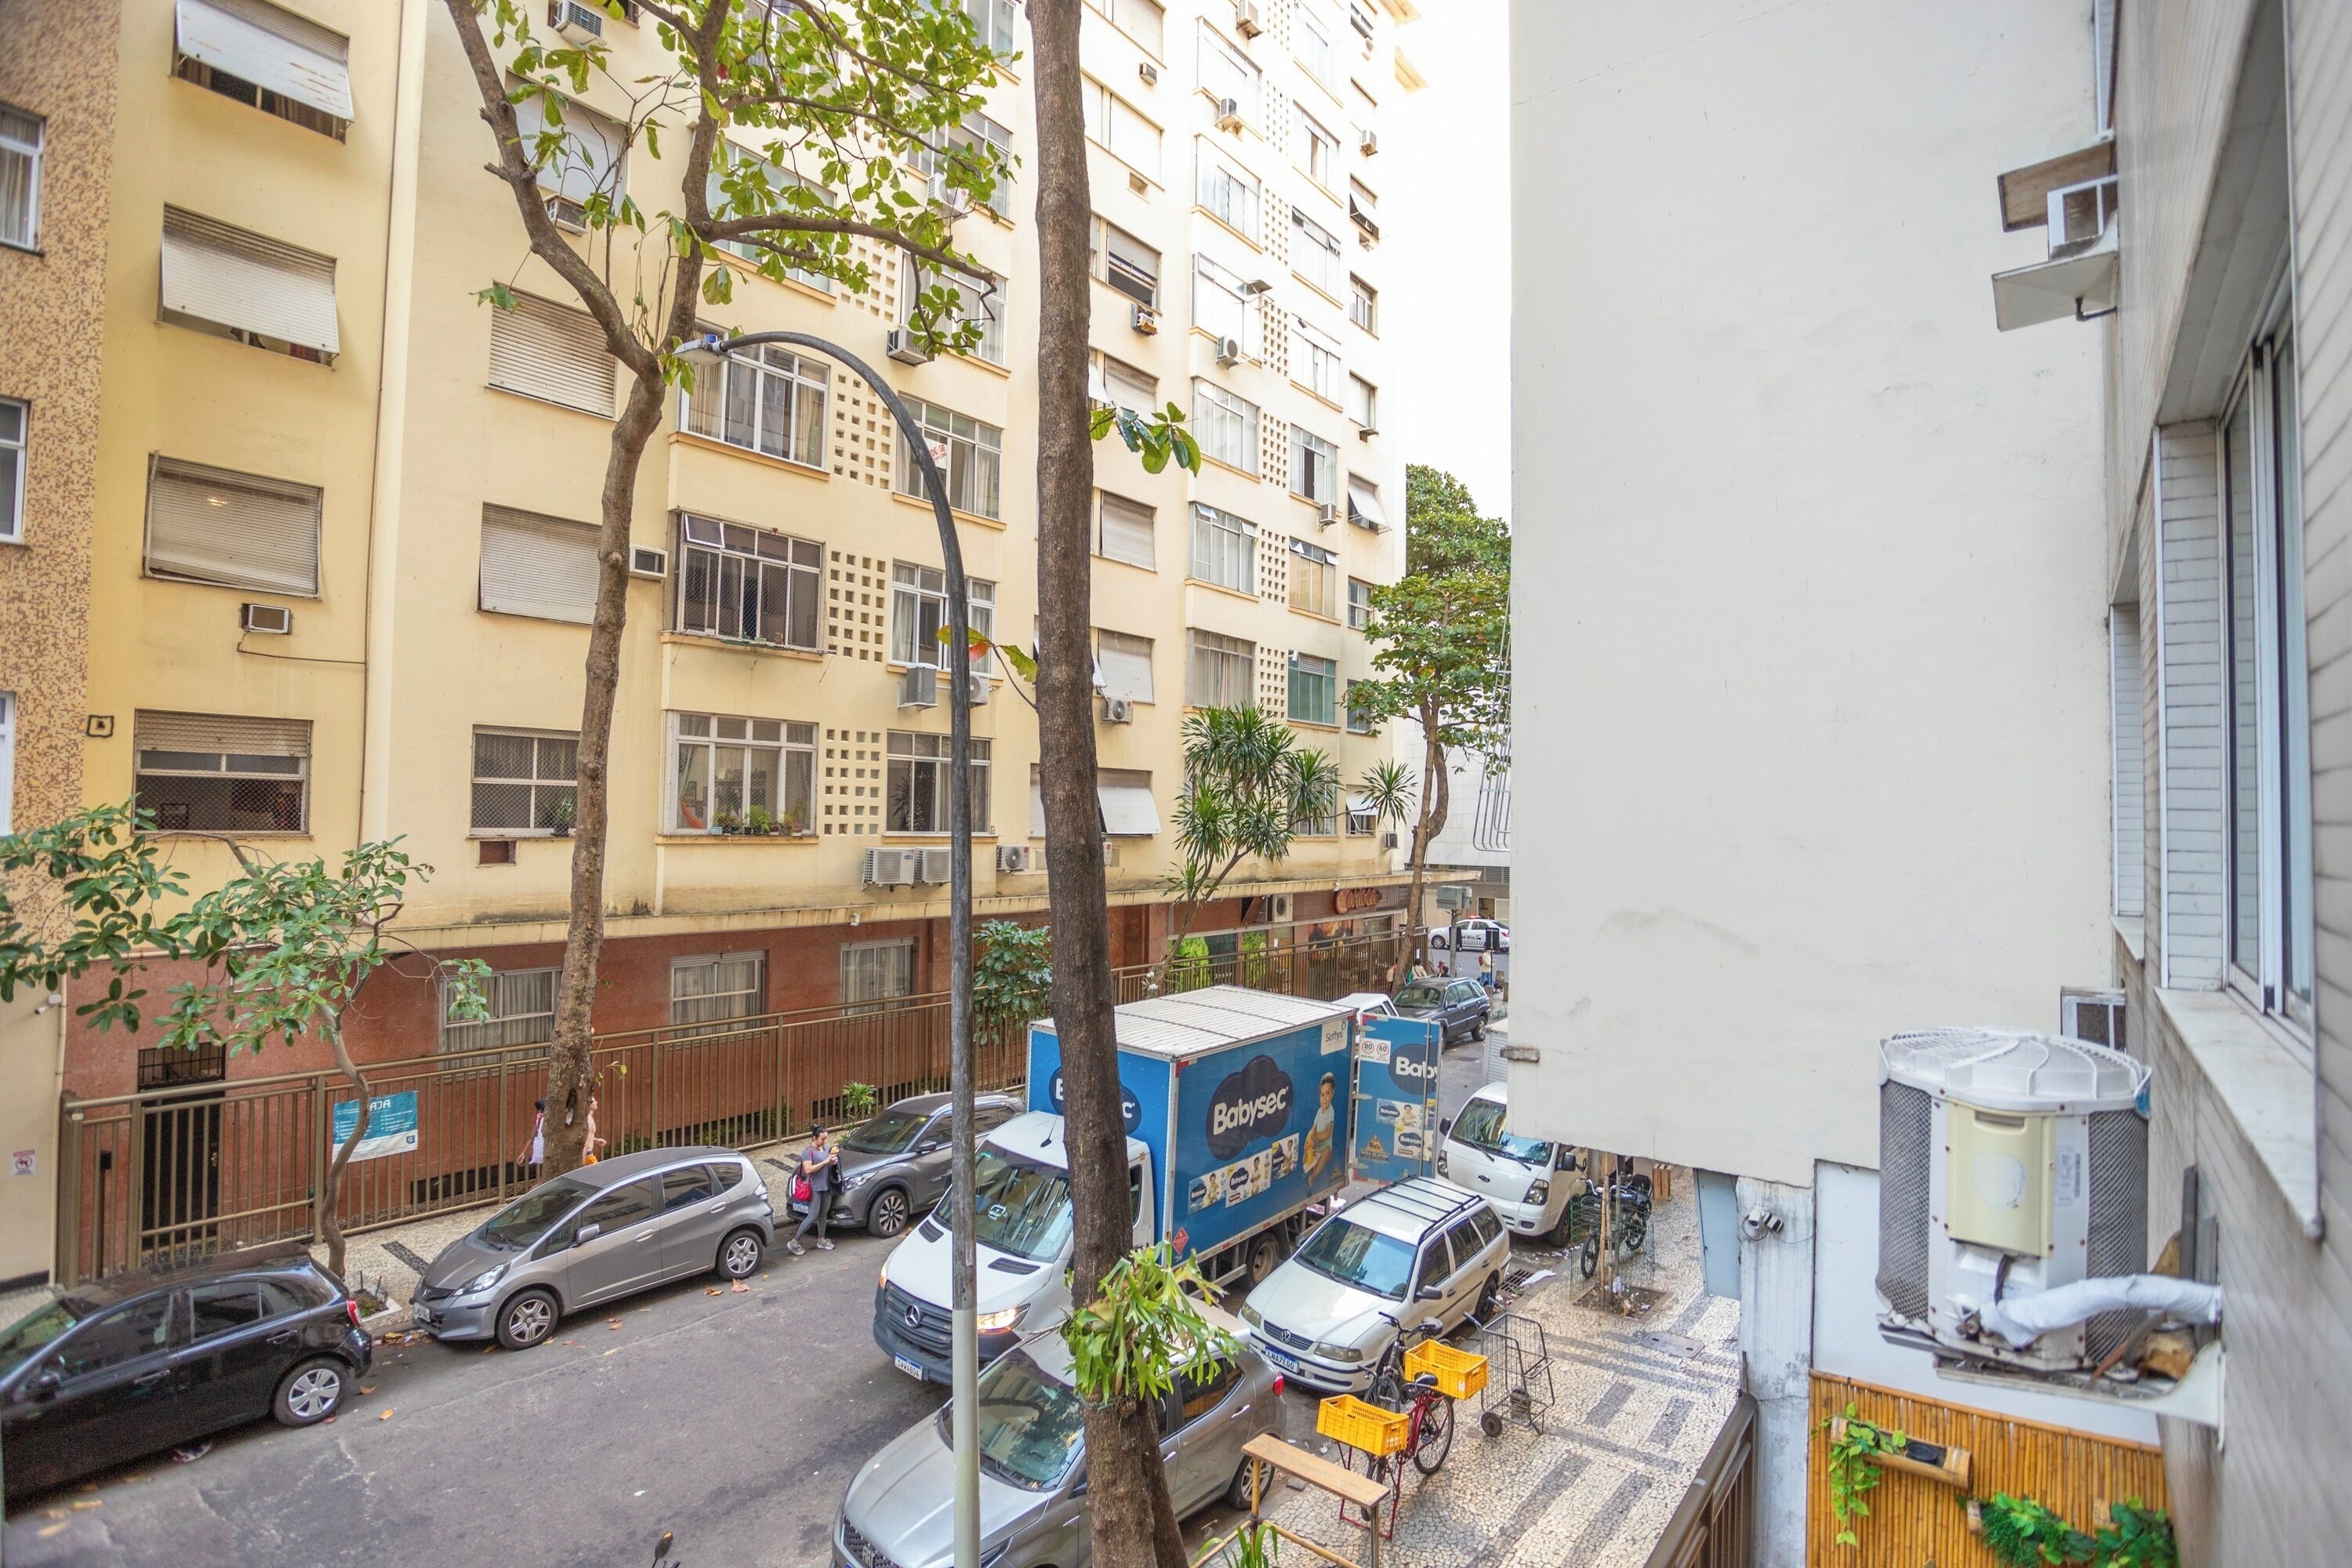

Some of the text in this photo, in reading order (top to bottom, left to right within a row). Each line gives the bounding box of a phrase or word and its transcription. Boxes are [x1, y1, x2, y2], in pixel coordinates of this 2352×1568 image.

[931, 445, 946, 457] DE-SE
[1325, 1030, 1343, 1042] Softys
[369, 1099, 390, 1112] AJA
[1213, 1087, 1287, 1135] Babysec
[1230, 1174, 1248, 1185] Babysec
